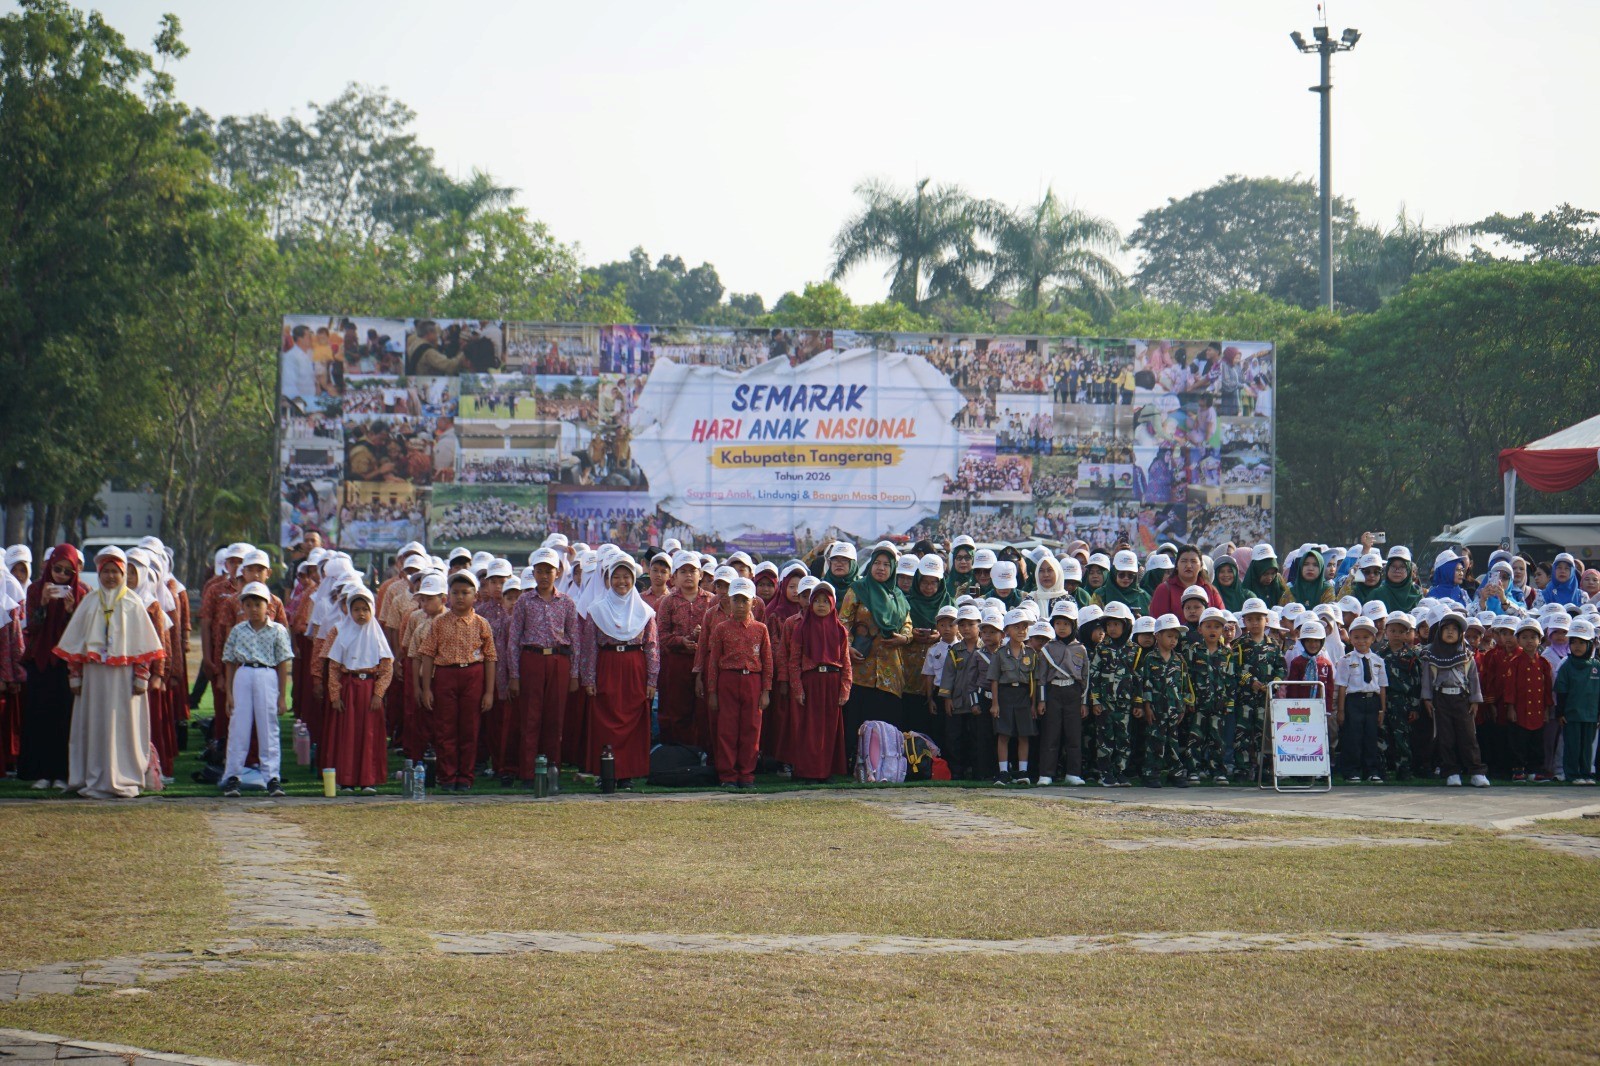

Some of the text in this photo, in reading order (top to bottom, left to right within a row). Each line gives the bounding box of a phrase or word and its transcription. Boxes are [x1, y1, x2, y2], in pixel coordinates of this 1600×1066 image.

[731, 384, 868, 412] SEMARAK
[691, 417, 917, 443] HARI ANAK NASIONAL
[721, 449, 893, 469] Kabupaten Tangerang
[775, 471, 831, 482] Tahun 2026
[686, 489, 911, 503] Sayang Anak, Lindungi & Bangun Masa Depan
[567, 507, 646, 519] DUTA ANAK
